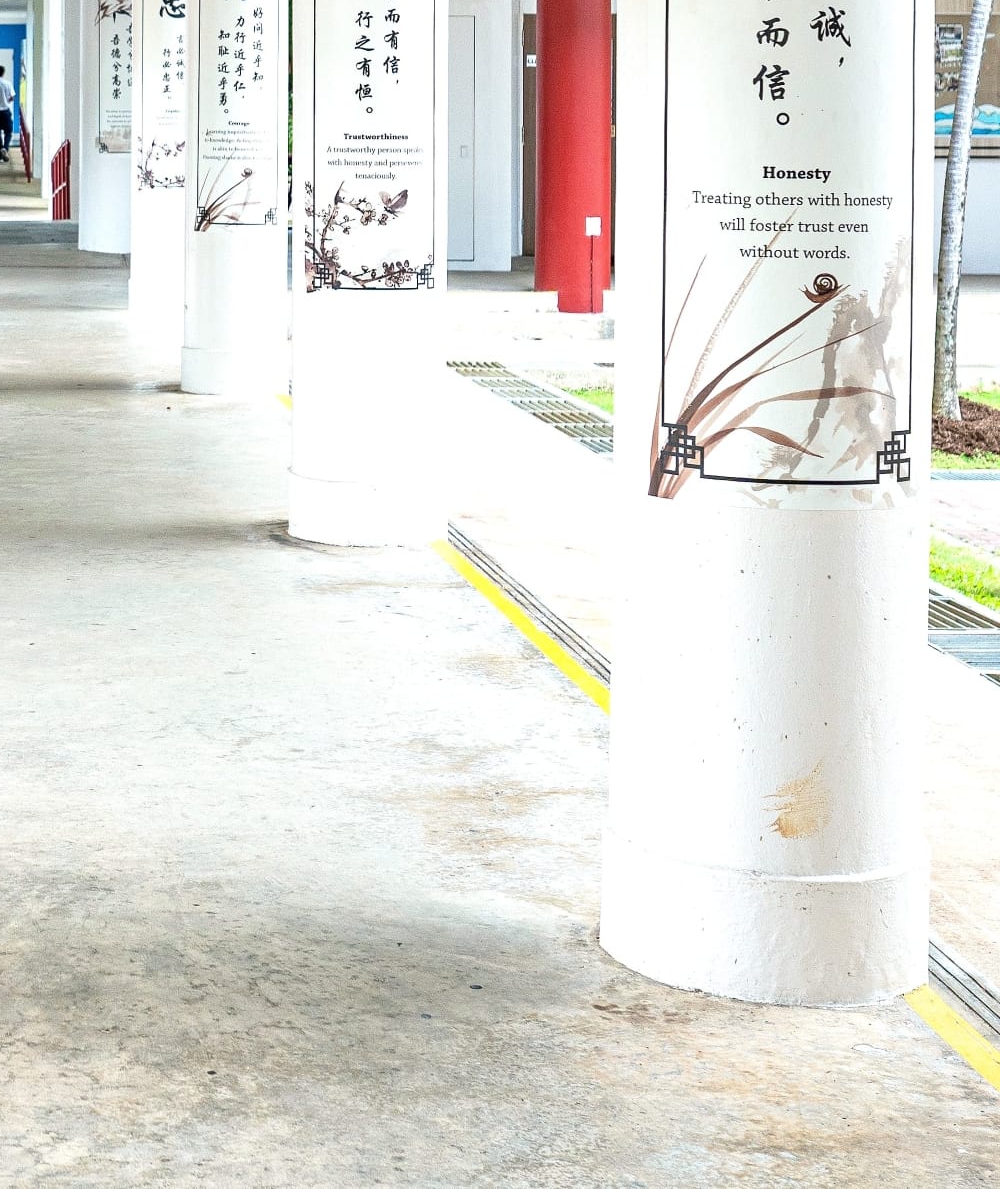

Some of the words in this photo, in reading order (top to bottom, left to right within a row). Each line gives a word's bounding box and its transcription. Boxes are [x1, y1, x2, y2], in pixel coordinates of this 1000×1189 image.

[354, 11, 375, 114] 行之有恒。
[344, 132, 408, 140] Trustworthiness
[334, 146, 376, 155] trustworthy
[344, 159, 372, 168] honesty
[355, 172, 397, 180] tenaciously.
[762, 166, 832, 184] Honesty
[692, 191, 752, 209] Treating
[755, 192, 805, 207] others
[807, 192, 840, 207] with
[843, 193, 893, 210] honesty
[720, 217, 746, 231] will
[749, 218, 795, 233] foster
[797, 221, 835, 234] trust
[837, 223, 869, 234] even
[739, 245, 800, 260] without
[802, 245, 850, 259] words.
